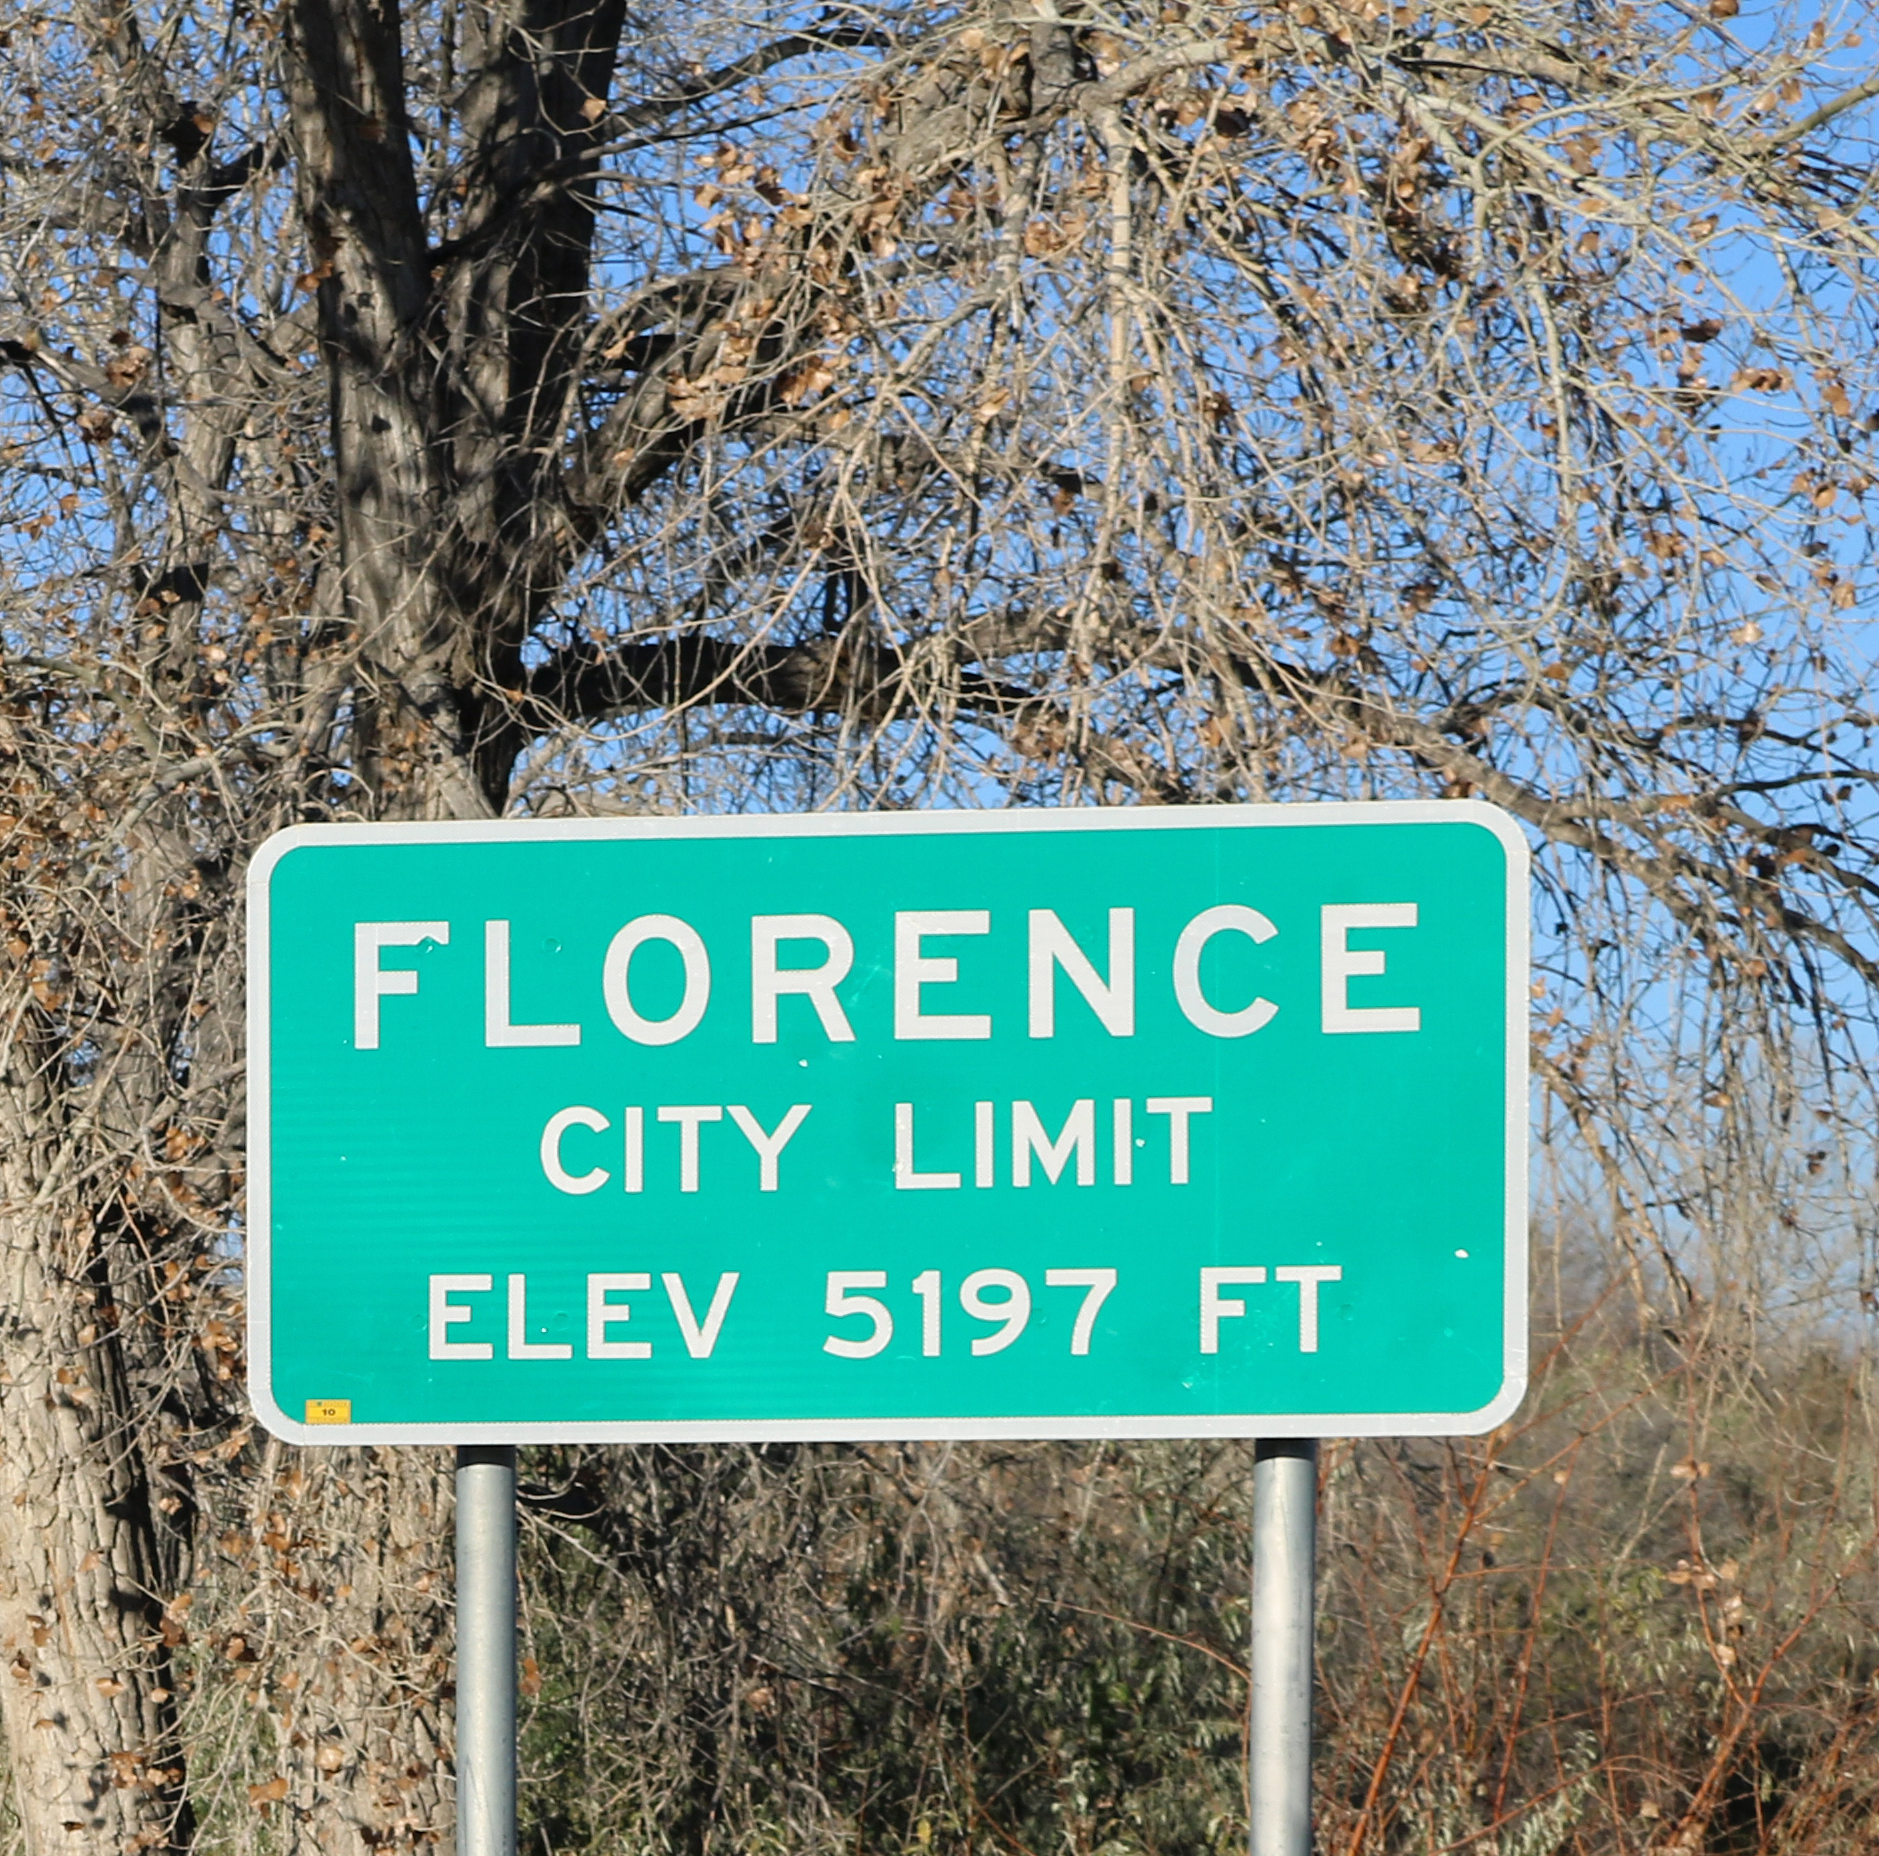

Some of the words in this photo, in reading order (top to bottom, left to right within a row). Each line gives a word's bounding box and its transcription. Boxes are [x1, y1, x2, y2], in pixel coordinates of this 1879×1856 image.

[354, 902, 1421, 1050] FLORENCE
[540, 1105, 812, 1195] CITY
[892, 1096, 1213, 1190] LIMIT
[429, 1272, 740, 1360] ELEV
[823, 1268, 1117, 1359] 5197
[1200, 1265, 1342, 1354] FT
[322, 1408, 336, 1416] 10
